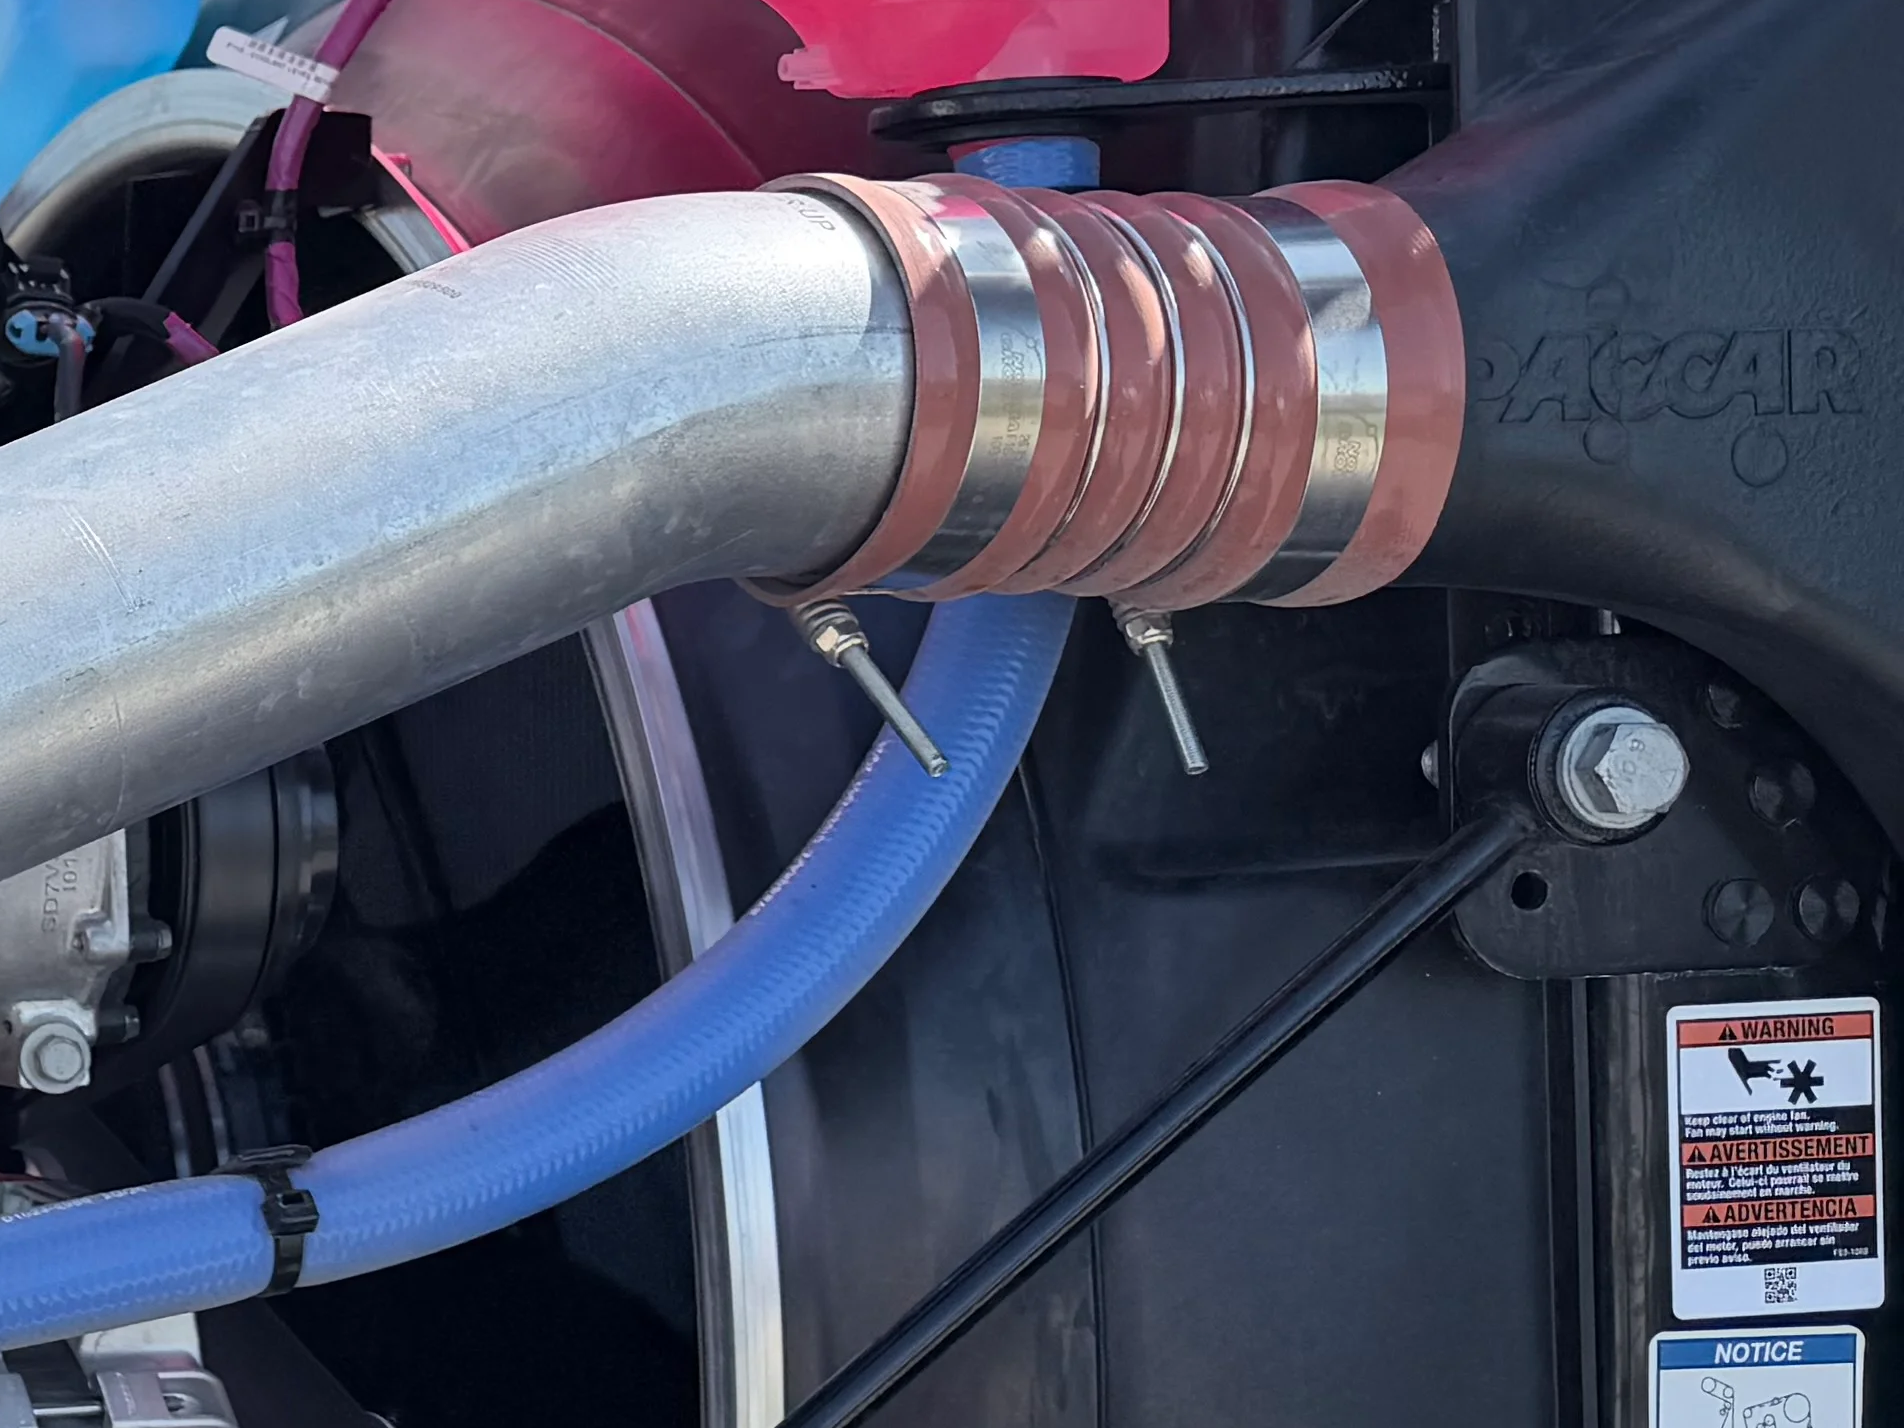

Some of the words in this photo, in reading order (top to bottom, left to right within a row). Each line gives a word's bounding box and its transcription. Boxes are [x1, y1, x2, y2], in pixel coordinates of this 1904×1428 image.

[1742, 1018, 1834, 1041] WARNING
[1684, 1116, 1710, 1127] Keep
[1712, 1115, 1738, 1125] clear
[1740, 1113, 1751, 1123] of
[1753, 1111, 1787, 1124] engine
[1685, 1127, 1703, 1138] Fan
[1705, 1126, 1726, 1138] may
[1729, 1124, 1753, 1135] start
[1755, 1122, 1794, 1134] without
[1795, 1120, 1839, 1133] warning.
[1710, 1136, 1869, 1161] AVERTISSEMENT
[1724, 1197, 1857, 1223] ADVERTENCIA
[1714, 1340, 1804, 1364] NOTICE
